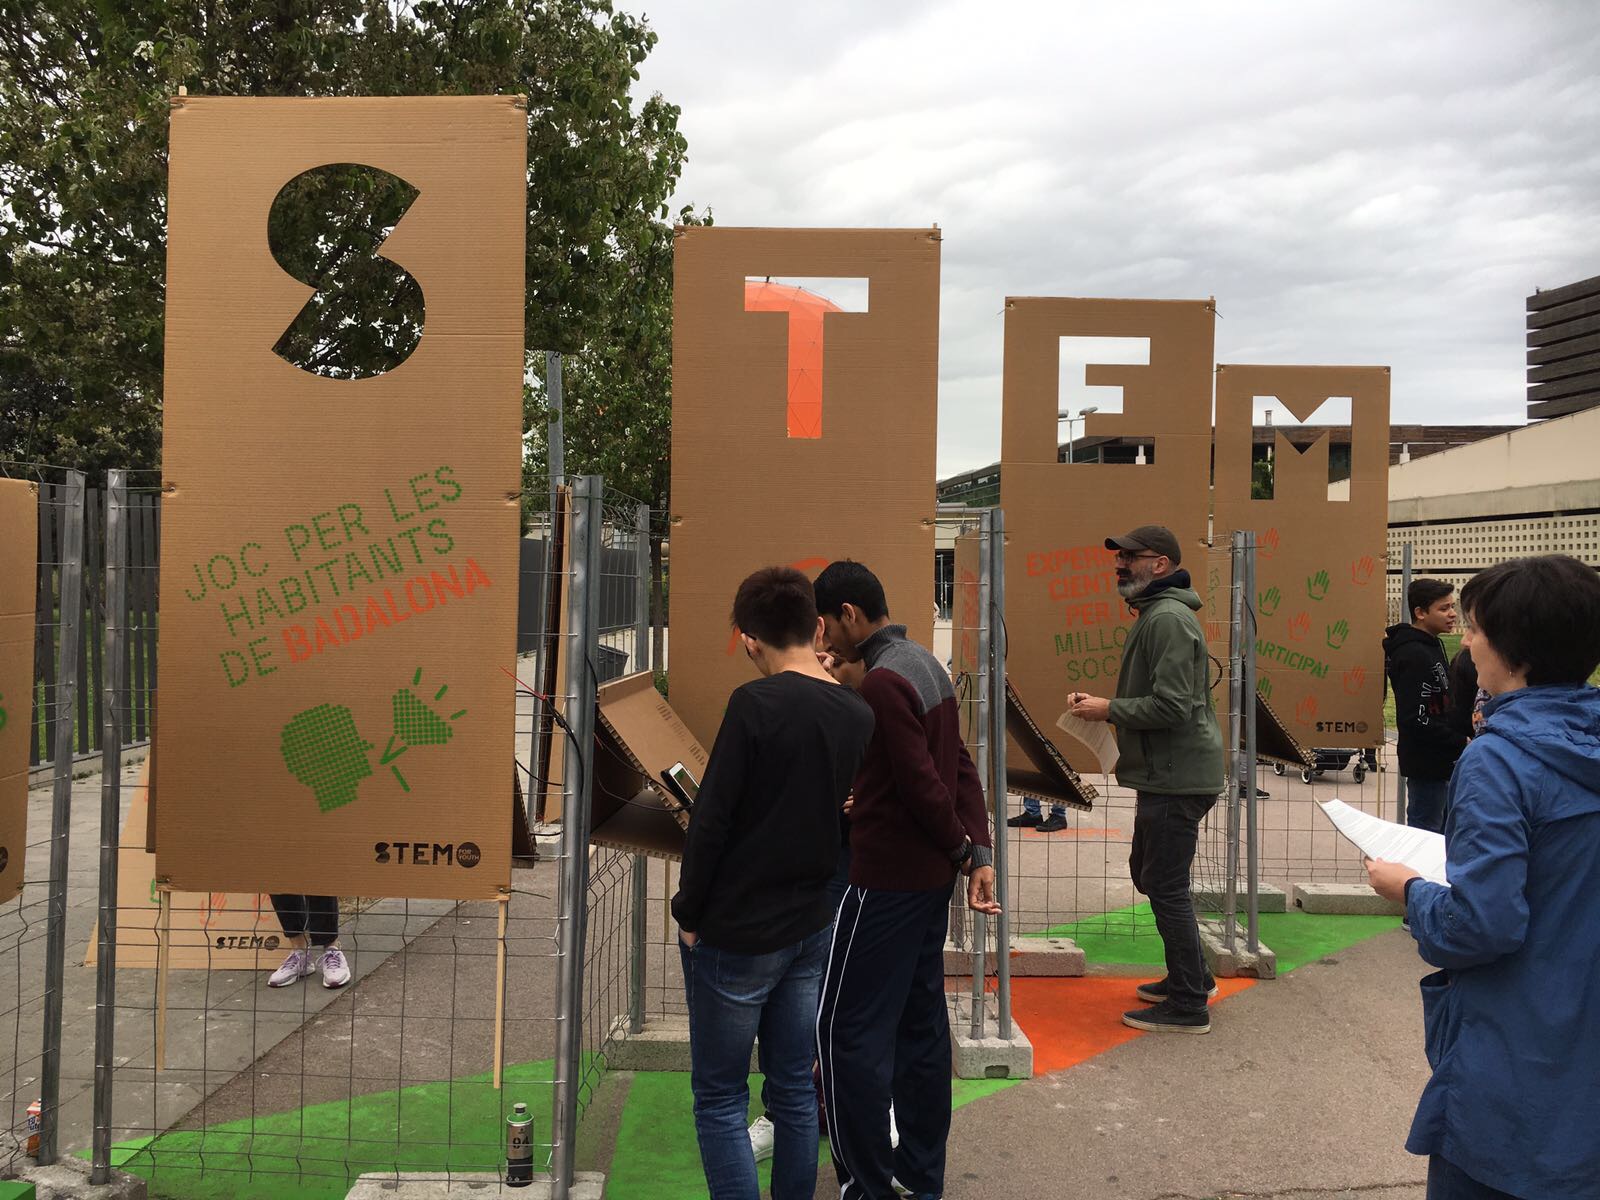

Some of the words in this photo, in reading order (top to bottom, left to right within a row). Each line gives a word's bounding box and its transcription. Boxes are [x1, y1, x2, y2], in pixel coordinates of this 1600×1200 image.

[267, 162, 426, 380] S
[744, 275, 869, 439] T
[1057, 335, 1155, 465] E
[1251, 395, 1353, 502] M
[185, 542, 270, 602] JOC
[284, 503, 370, 562] PER
[384, 465, 463, 523] LES
[219, 518, 455, 638] HABITANTS
[1048, 571, 1118, 603] CIENT
[219, 636, 279, 689] DE
[282, 558, 493, 664] BADALONA
[1054, 626, 1129, 656] MILLO
[1066, 655, 1119, 682] SOC
[1315, 721, 1350, 733] STEM
[374, 841, 454, 866] STEM
[215, 936, 264, 950] STEM
